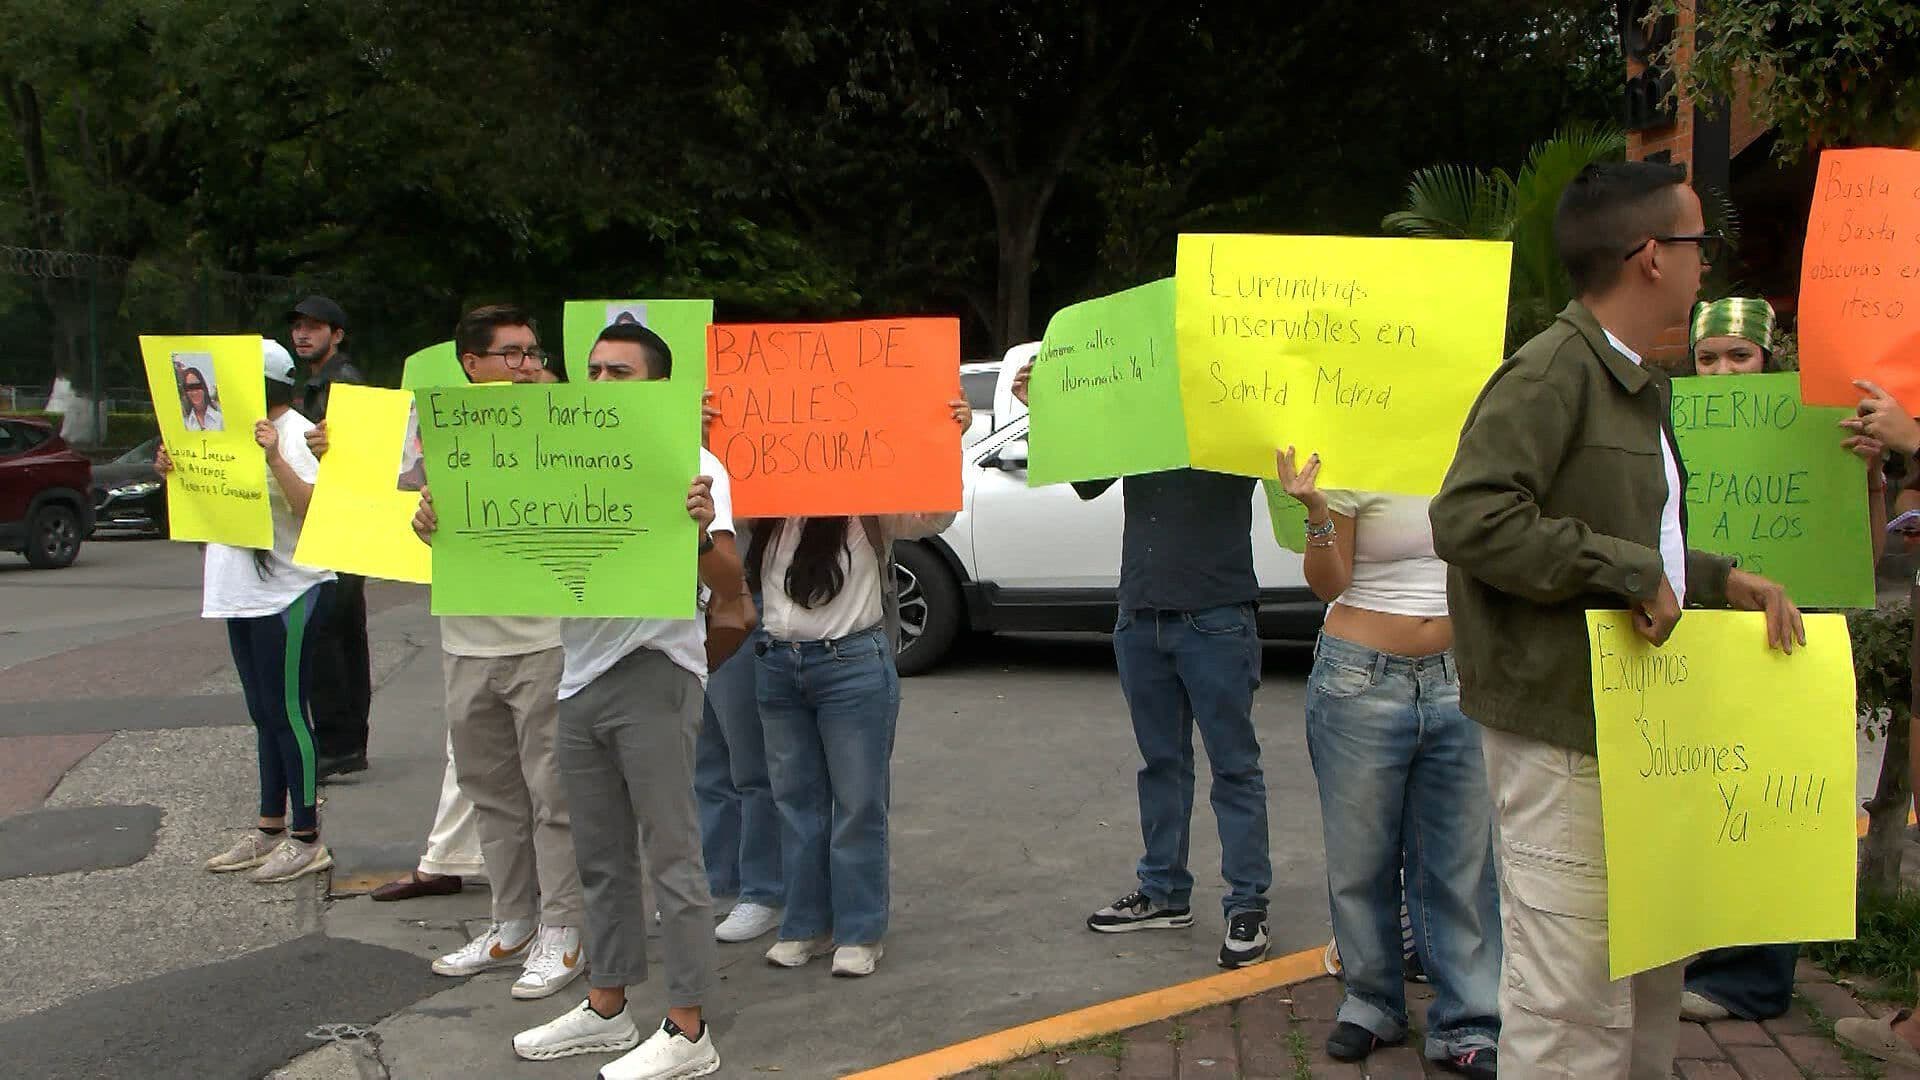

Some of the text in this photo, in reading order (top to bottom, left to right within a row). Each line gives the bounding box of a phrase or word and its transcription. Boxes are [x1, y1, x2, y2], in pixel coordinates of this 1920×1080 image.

[1825, 160, 1889, 201] Basta
[714, 327, 914, 376] BASTA DE
[1377, 323, 1416, 348] en
[719, 381, 858, 429] CALLES
[1210, 361, 1288, 406] Santa
[431, 391, 620, 428] Estamos hartos
[1672, 391, 1798, 430] BIERNO
[448, 433, 633, 470] de las luminarias
[725, 429, 895, 481] OBSCURAS
[466, 480, 633, 527] Inservibles
[1686, 472, 1811, 505] EPAQUE
[1712, 511, 1803, 540] A LOS
[1597, 623, 1688, 722] Exigimos
[1640, 719, 1748, 778] Soluciones
[1717, 783, 1748, 845] Ya
